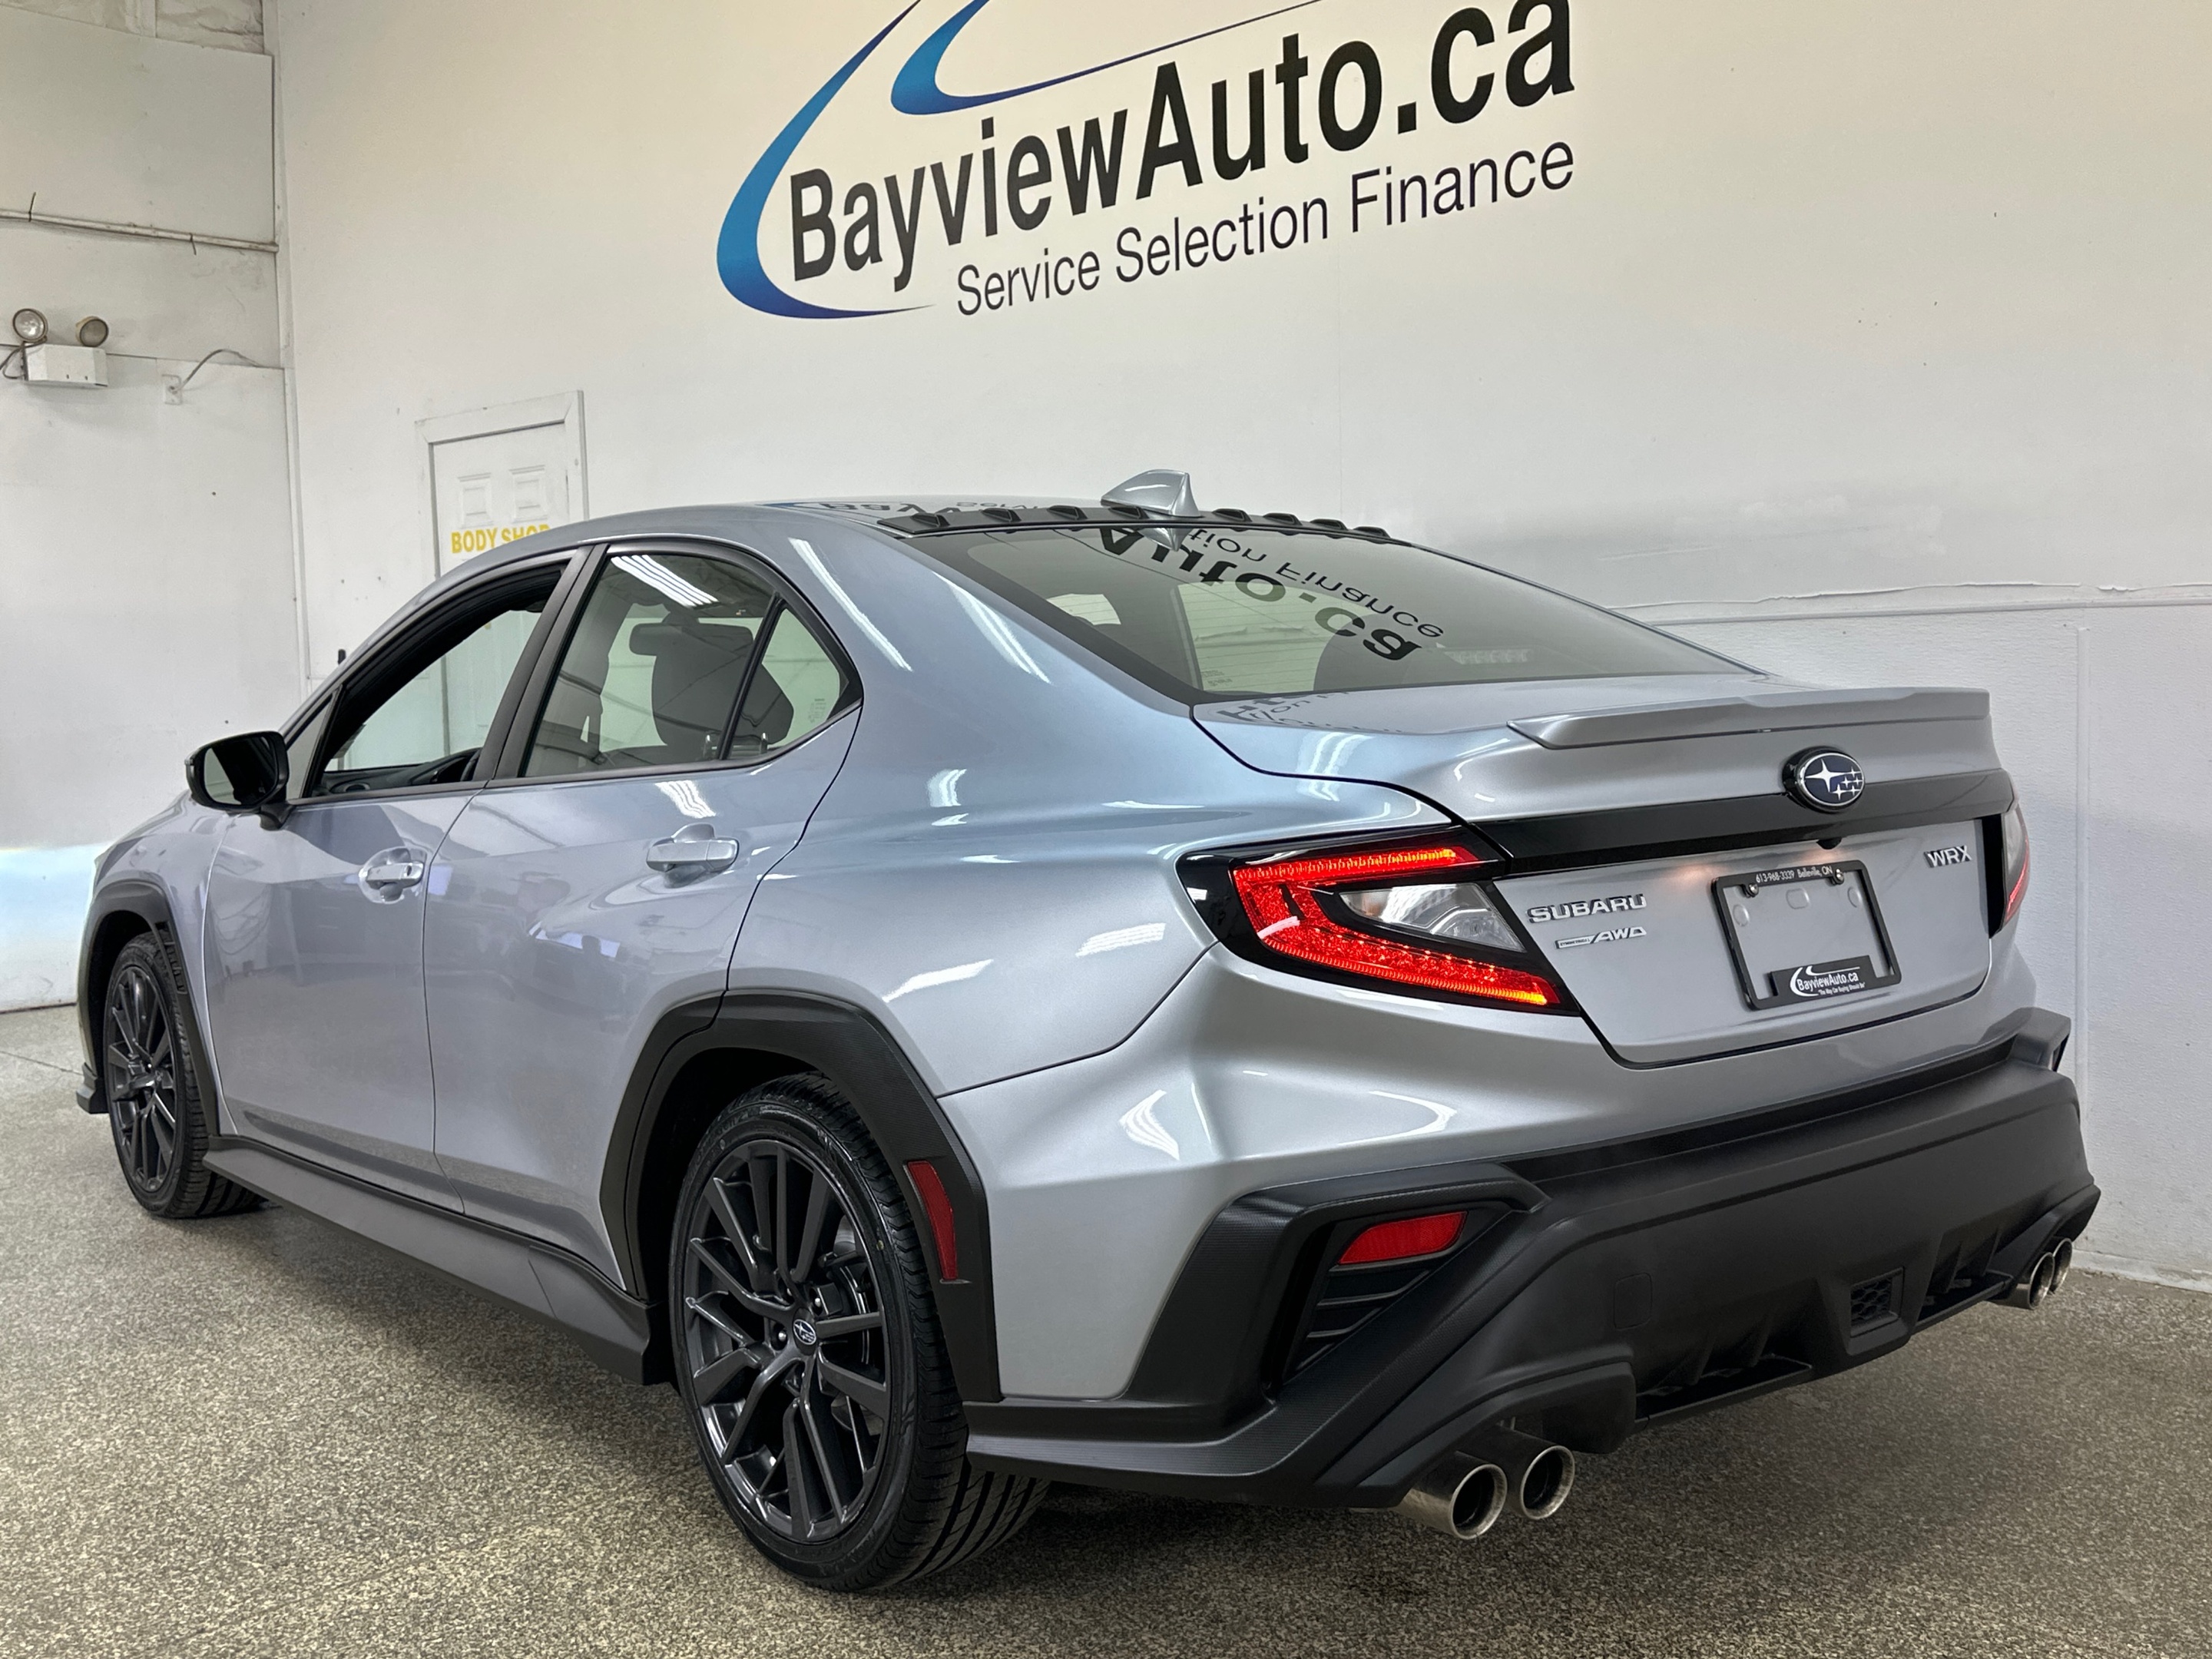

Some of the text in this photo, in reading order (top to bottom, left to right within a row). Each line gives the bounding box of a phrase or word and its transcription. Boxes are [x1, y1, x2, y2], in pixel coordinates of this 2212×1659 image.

[790, 0, 1575, 293] BayviewAuto.ca
[957, 141, 1575, 316] Service Selection Finance
[450, 524, 551, 554] BODY SH
[1924, 845, 1972, 868] WRX
[1822, 866, 1833, 876] ON
[1526, 893, 1647, 923] SUBARU
[1591, 926, 1647, 945] AWD
[1796, 972, 1859, 992] BayviewAuto.ca
